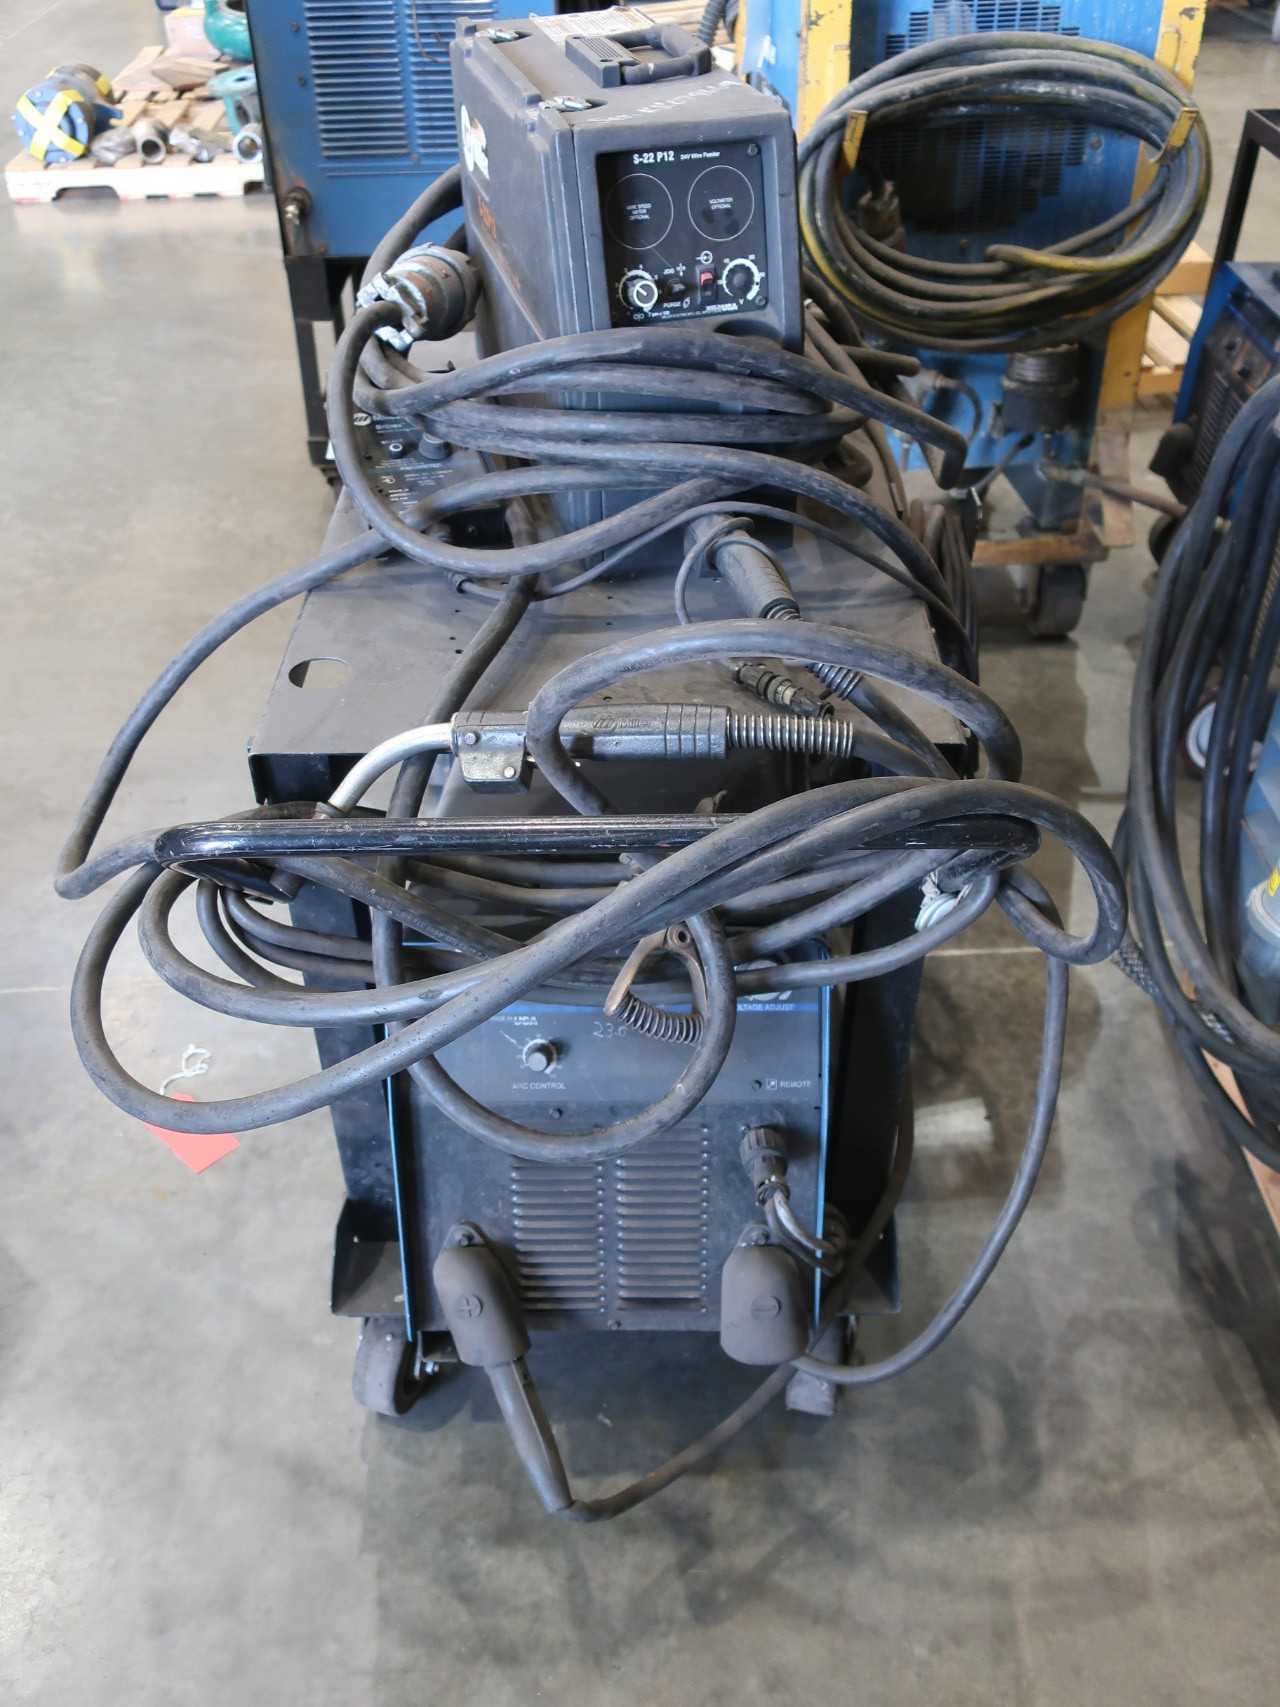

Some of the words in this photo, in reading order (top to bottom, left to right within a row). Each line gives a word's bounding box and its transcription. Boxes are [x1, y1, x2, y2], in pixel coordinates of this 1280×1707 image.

[633, 153, 655, 164] S-22
[656, 150, 675, 162] P12
[530, 1082, 567, 1090] CONTROL
[780, 1080, 811, 1088] REMOTE
